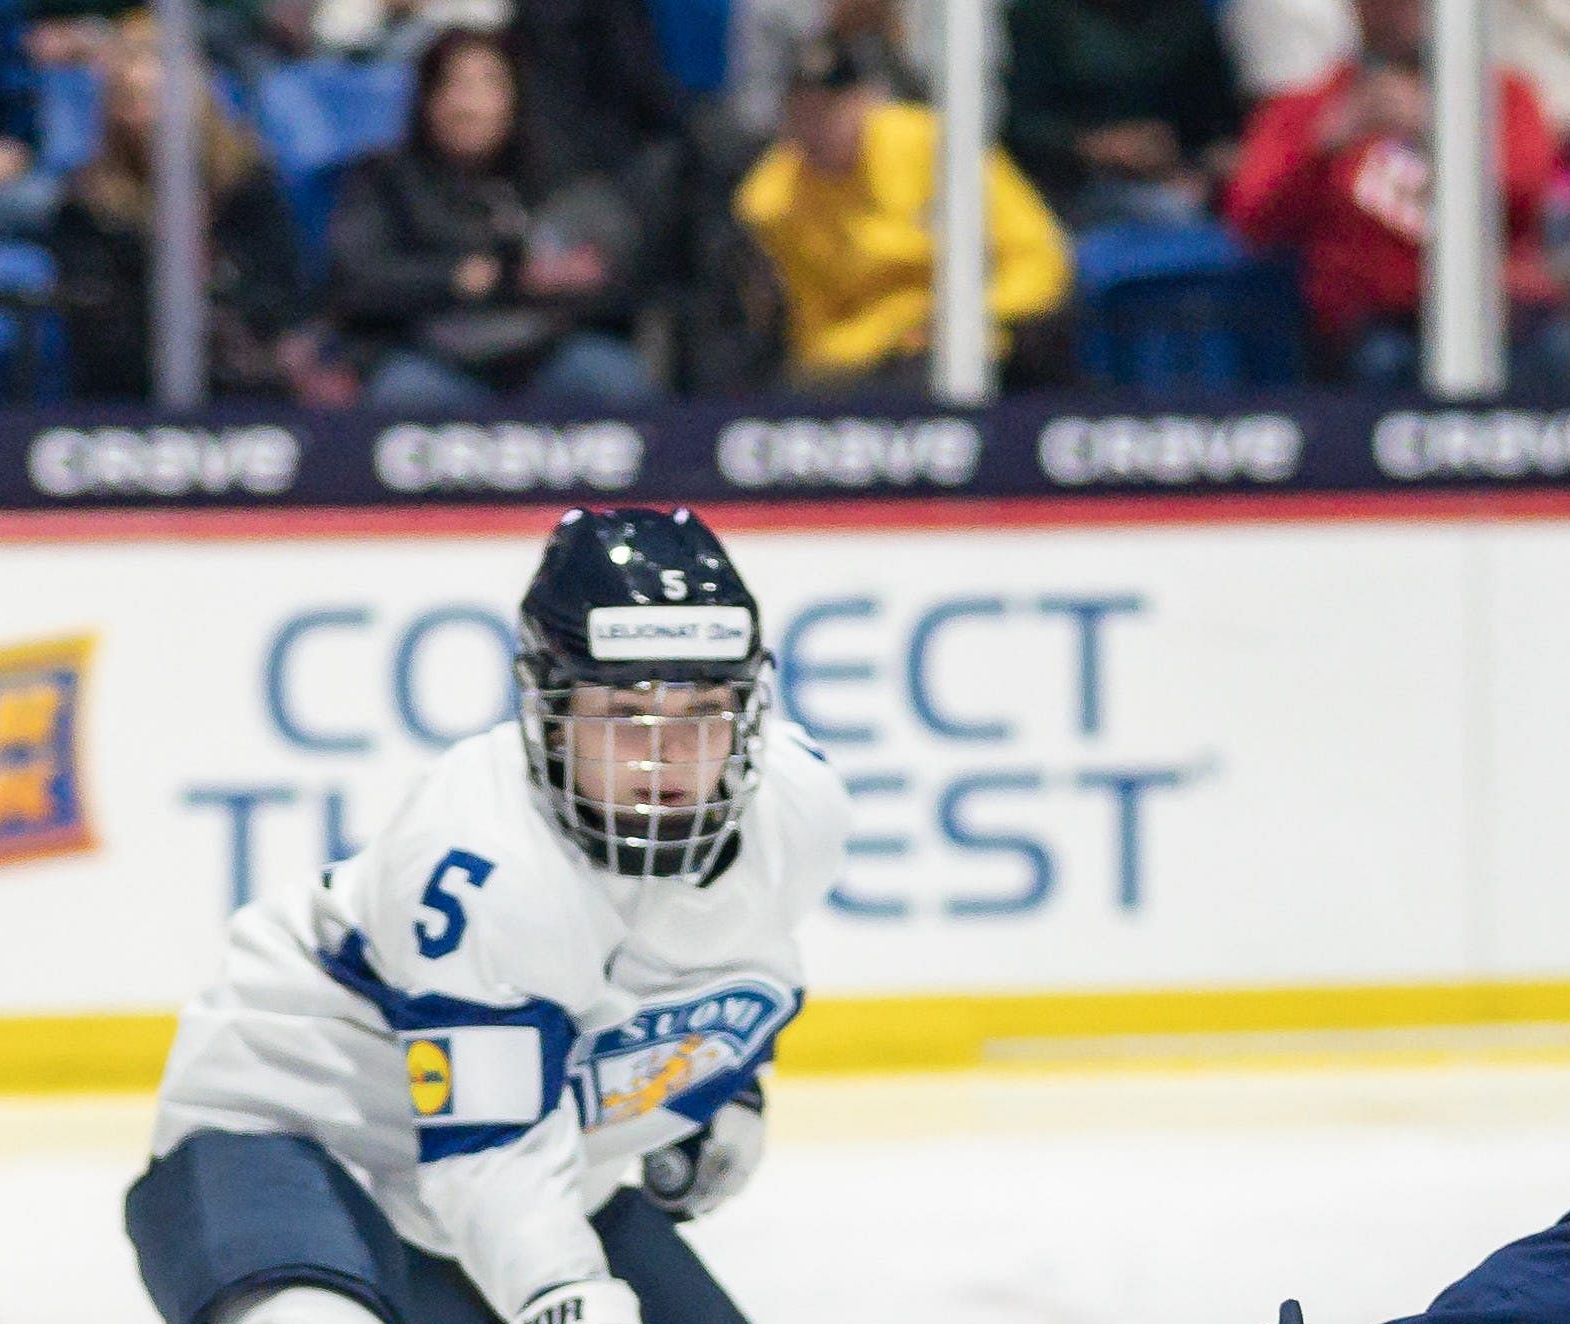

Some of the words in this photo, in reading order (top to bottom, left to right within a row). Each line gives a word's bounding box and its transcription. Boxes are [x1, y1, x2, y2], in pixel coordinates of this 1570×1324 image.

[659, 569, 688, 601] 5
[262, 596, 1147, 757] COECT
[414, 848, 495, 960] 5
